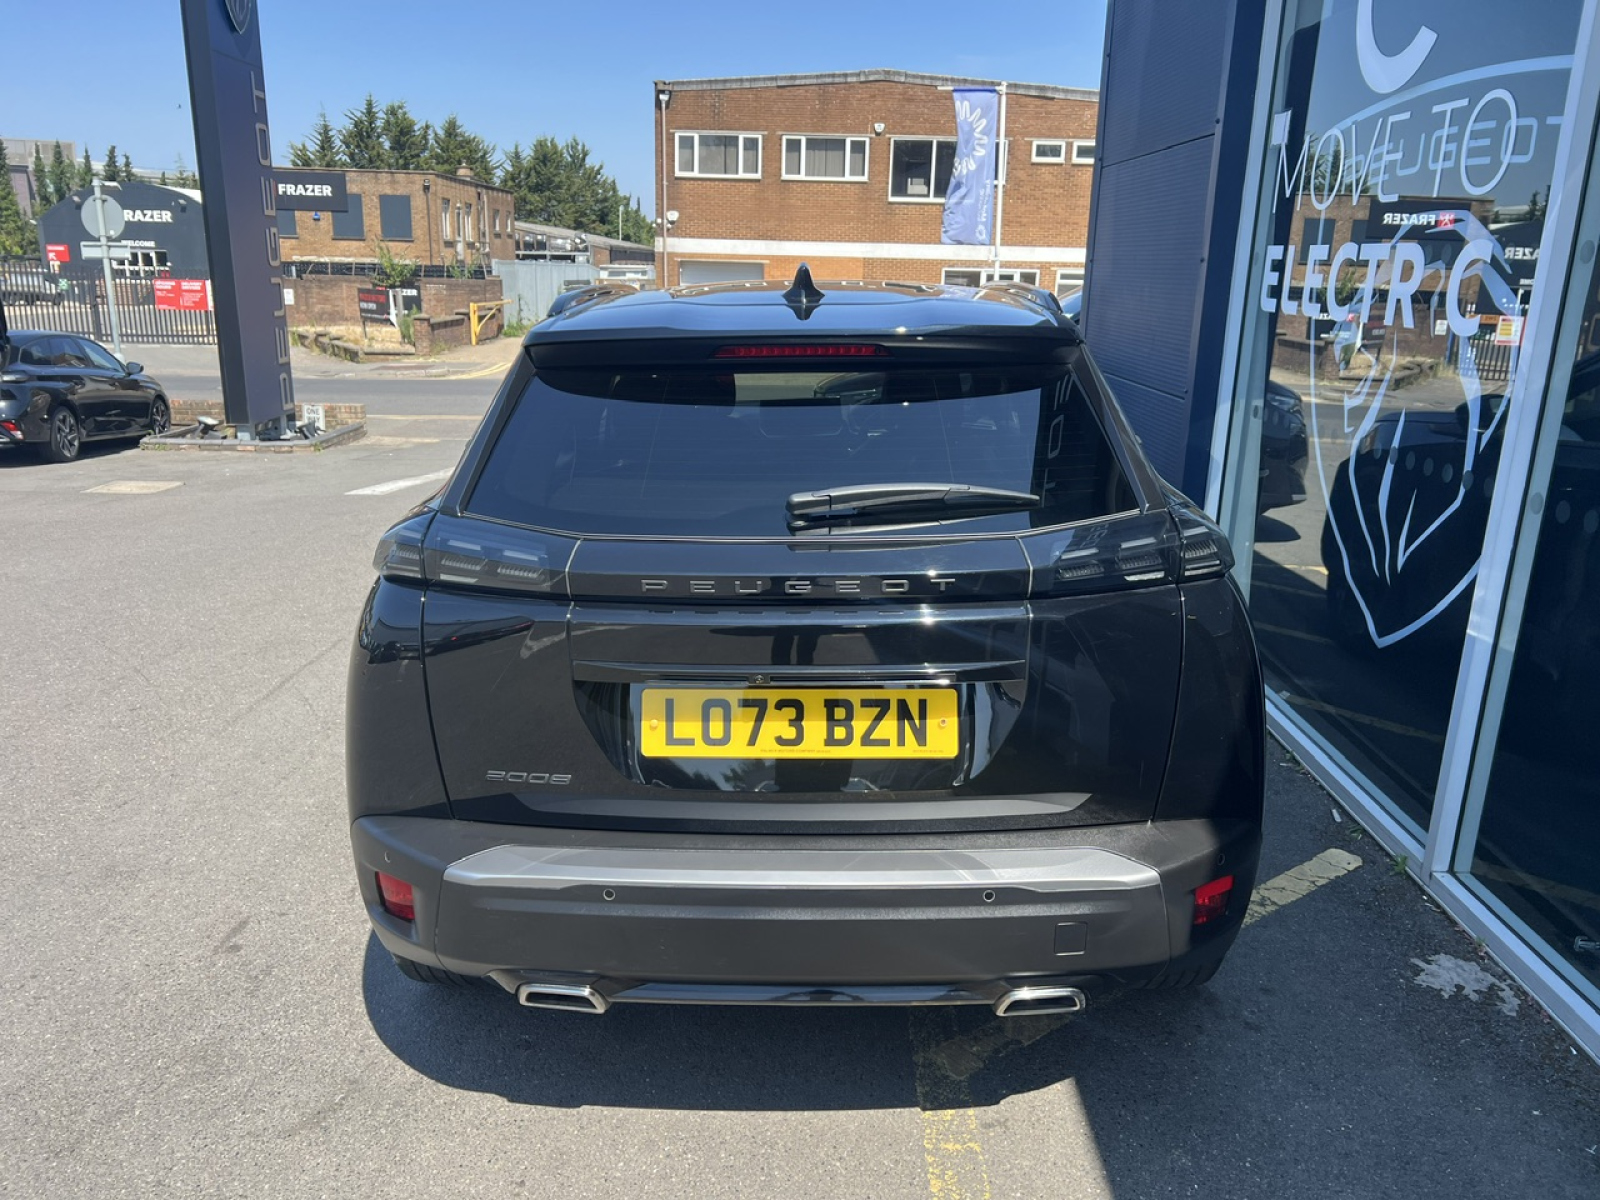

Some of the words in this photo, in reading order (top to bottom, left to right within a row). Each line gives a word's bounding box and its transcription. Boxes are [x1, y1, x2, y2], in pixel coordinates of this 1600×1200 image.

[1273, 111, 1410, 214] MOVE
[1432, 88, 1518, 197] TO
[277, 183, 333, 197] FRAZER
[123, 209, 173, 223] RAZER
[250, 70, 295, 411] PEUGEOT
[641, 578, 956, 593] PEUGEOT
[665, 698, 805, 747] LO73
[823, 698, 928, 747] BZN
[485, 770, 572, 785] 2008
